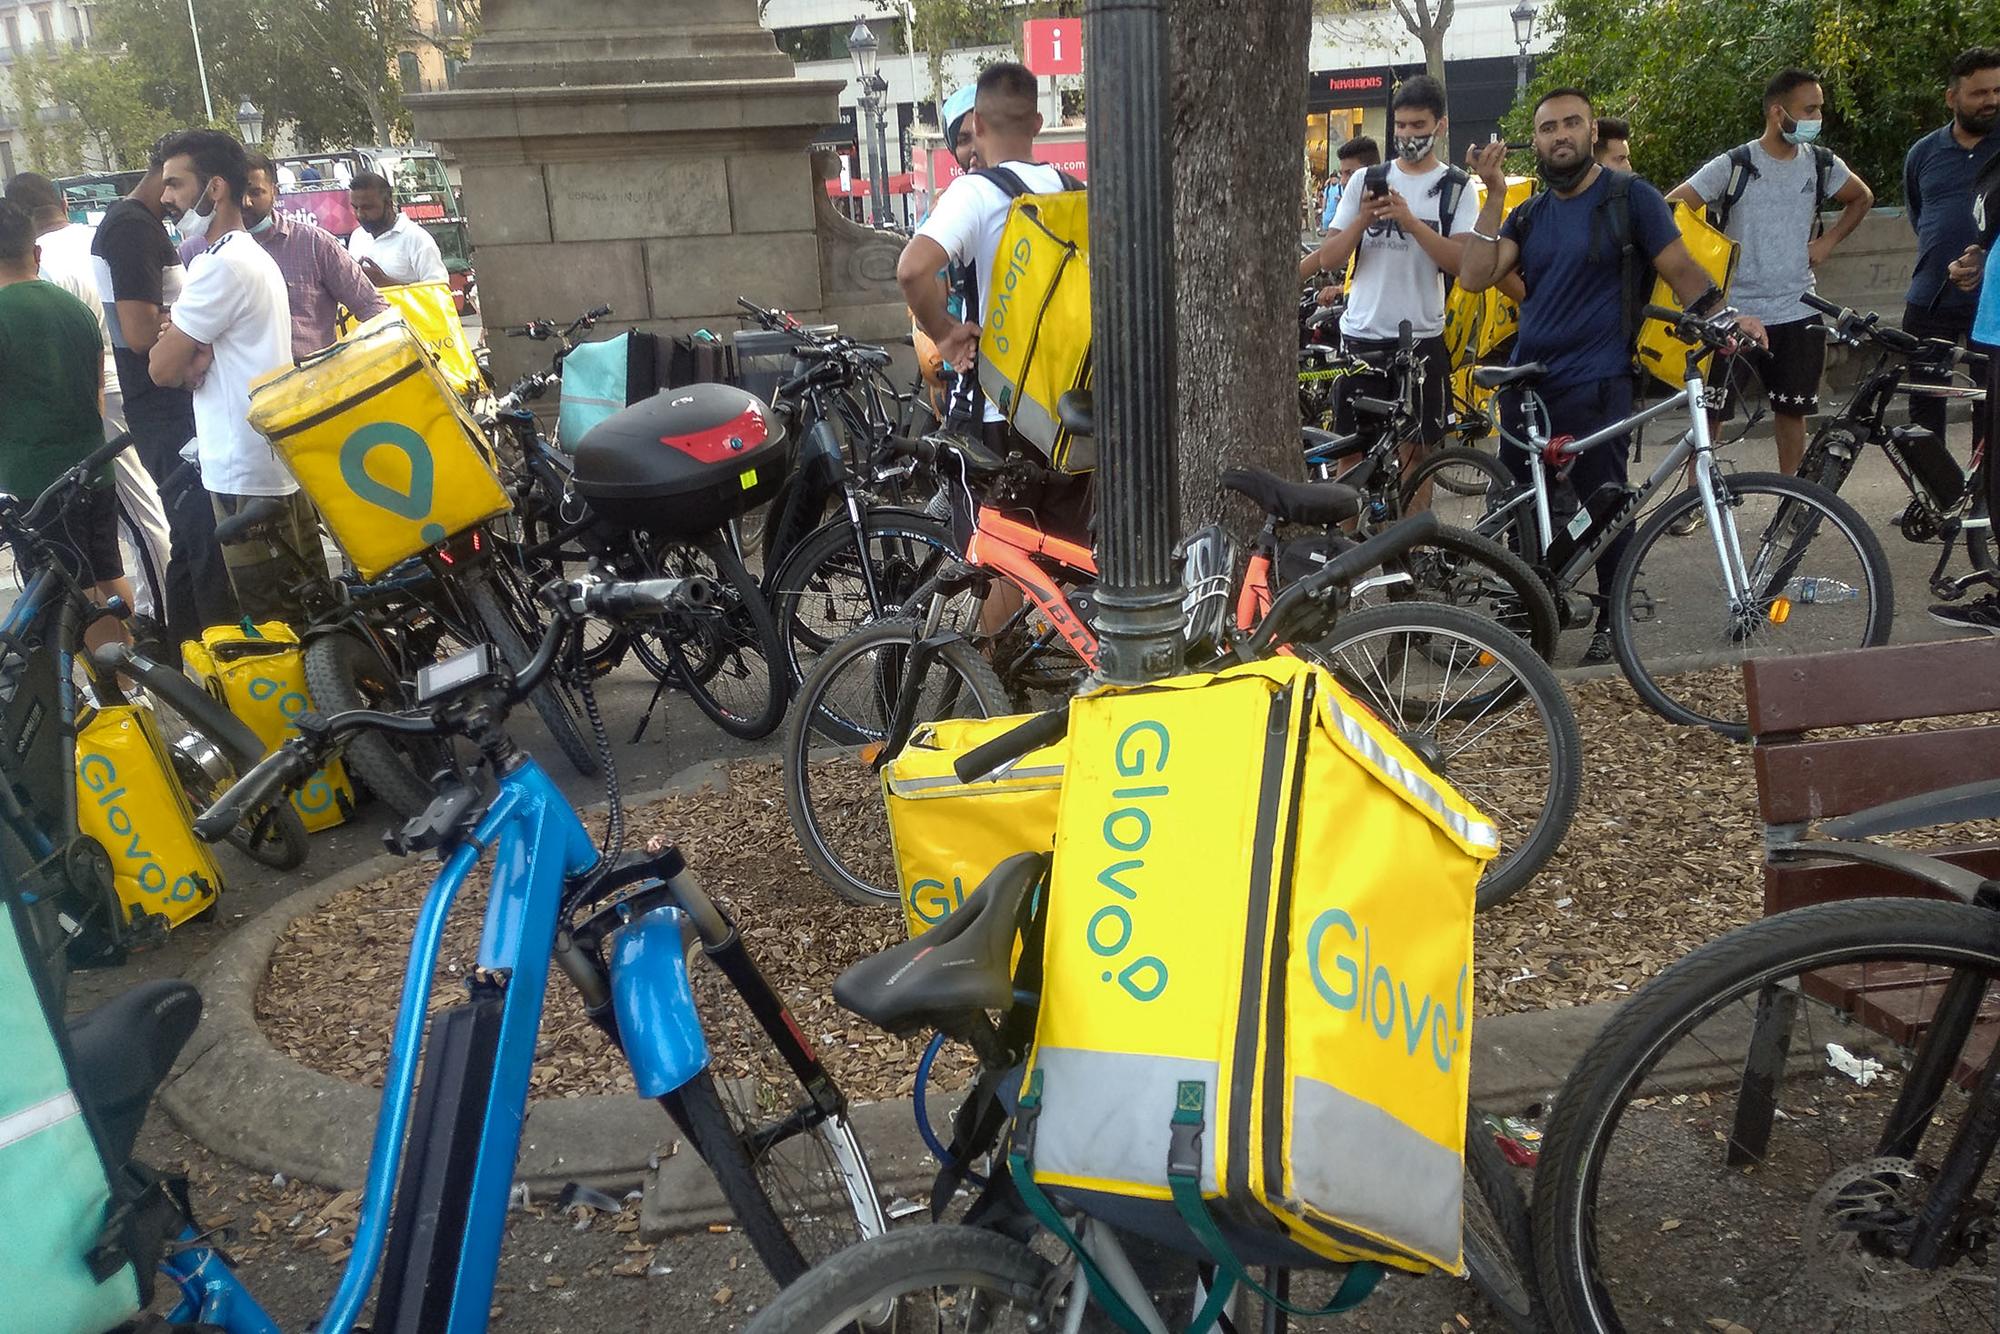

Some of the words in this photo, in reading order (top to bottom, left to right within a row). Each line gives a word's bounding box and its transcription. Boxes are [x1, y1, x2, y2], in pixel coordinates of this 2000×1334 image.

[991, 238, 1031, 331] Glovo
[79, 753, 167, 894] Glovo
[1087, 720, 1170, 957] Glovo
[910, 876, 966, 926] Gl
[1306, 908, 1451, 1073] Glovo
